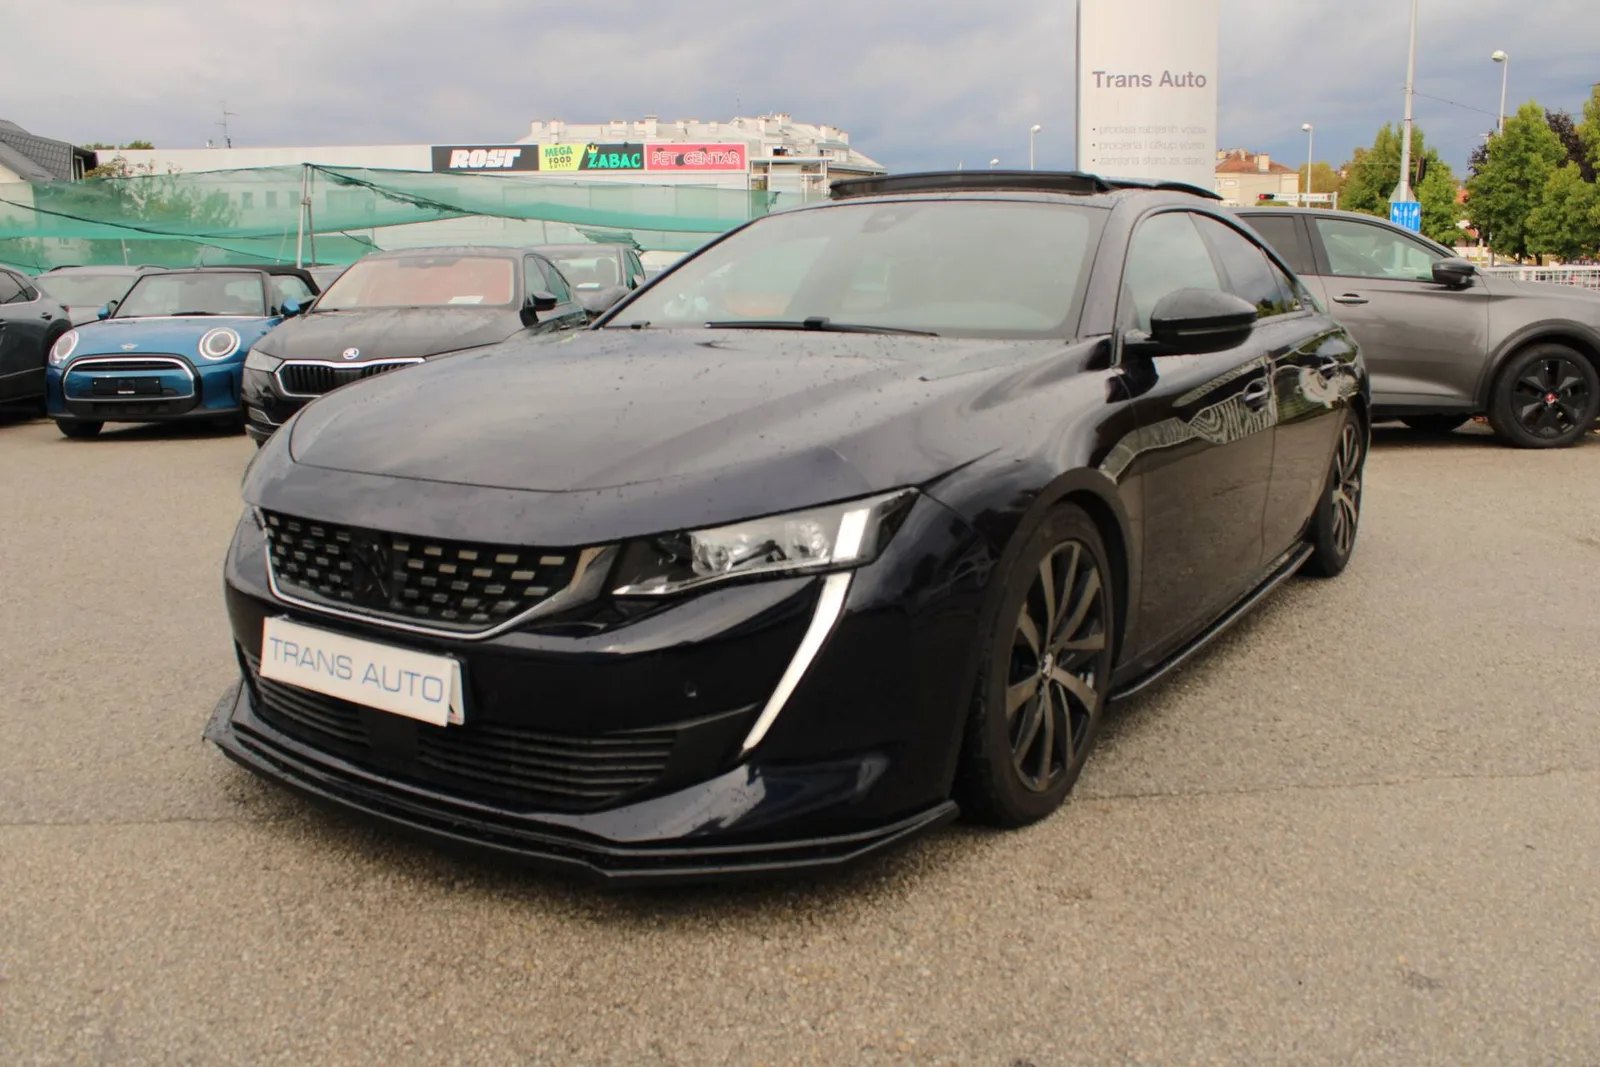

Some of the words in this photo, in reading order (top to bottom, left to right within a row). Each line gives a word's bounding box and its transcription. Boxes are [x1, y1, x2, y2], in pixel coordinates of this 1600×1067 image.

[1092, 71, 1152, 88] Trans
[1159, 70, 1207, 88] Auto
[545, 146, 573, 157] MEGA
[652, 151, 679, 165] PET
[683, 151, 740, 165] CENTAR
[549, 156, 572, 165] FOOD
[269, 636, 353, 681] TRANS
[362, 662, 444, 704] AUTO
